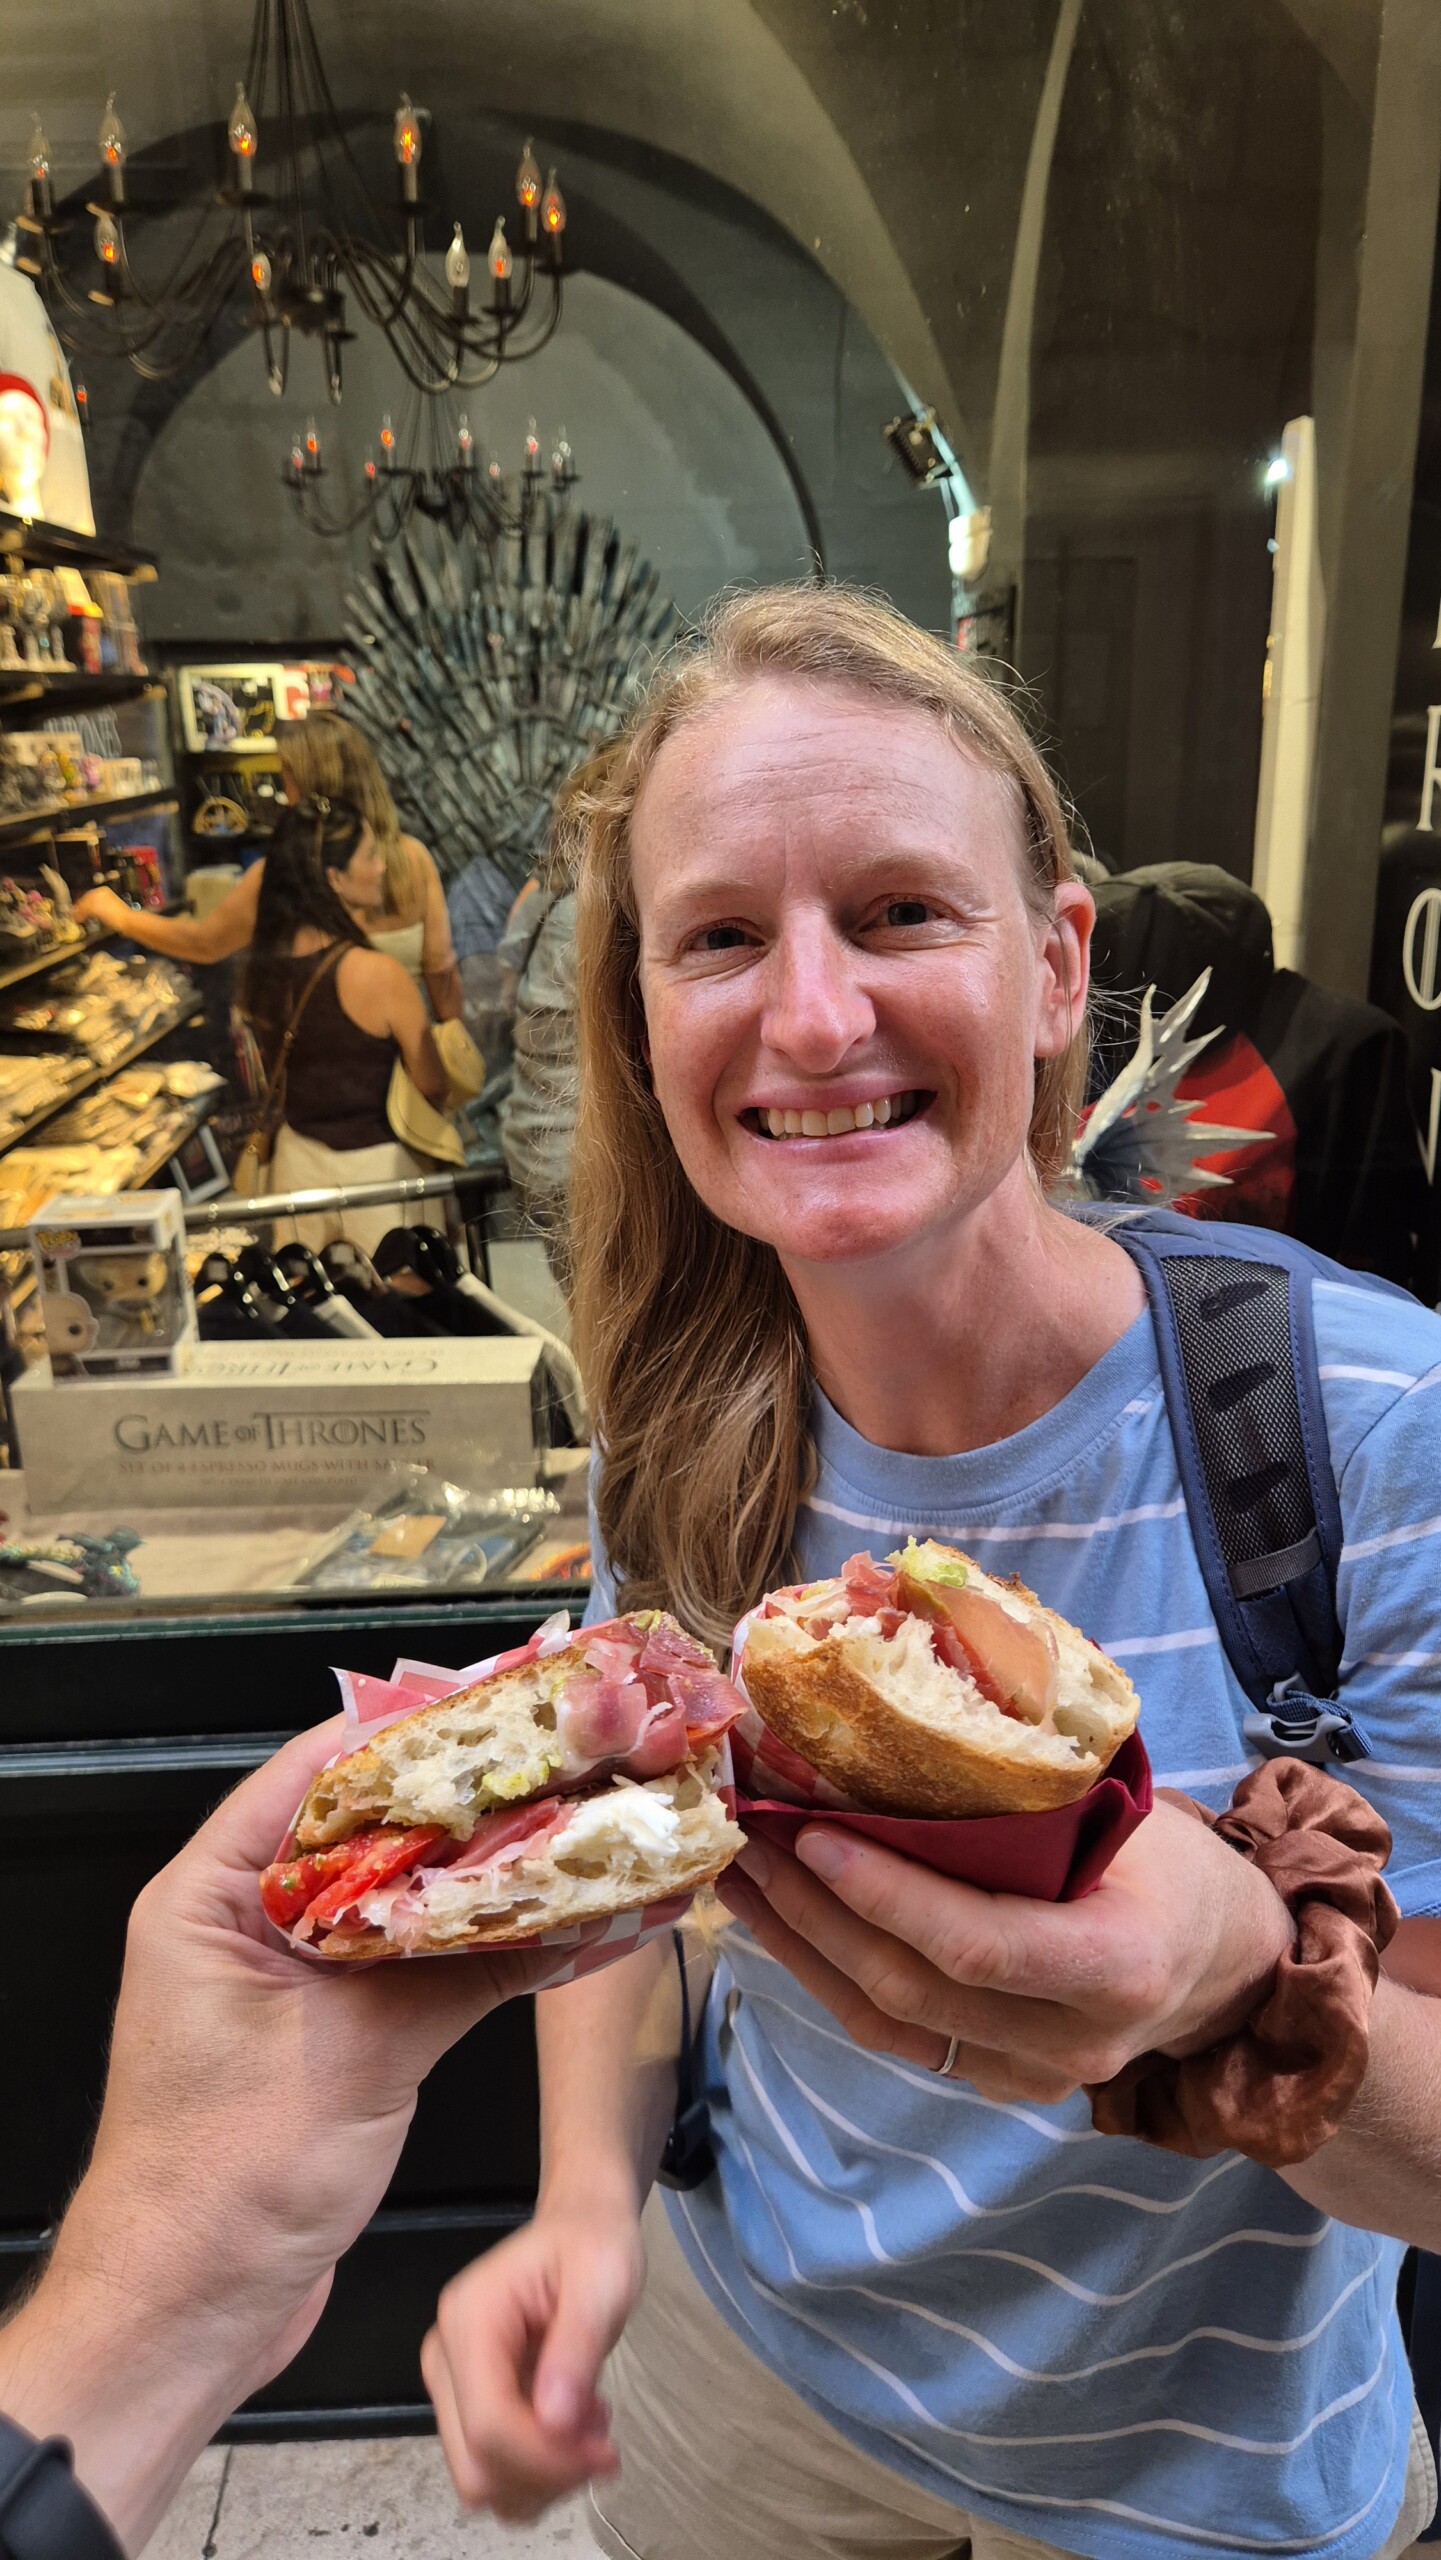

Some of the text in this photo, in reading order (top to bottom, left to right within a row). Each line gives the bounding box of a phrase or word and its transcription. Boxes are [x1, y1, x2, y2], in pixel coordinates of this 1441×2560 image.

[114, 1409, 431, 1454] GAME OF THRONES
[151, 1460, 171, 1474] OF
[191, 1459, 267, 1474] ESPRESSO
[271, 1459, 319, 1472] MUGS
[324, 1457, 369, 1471] WITH
